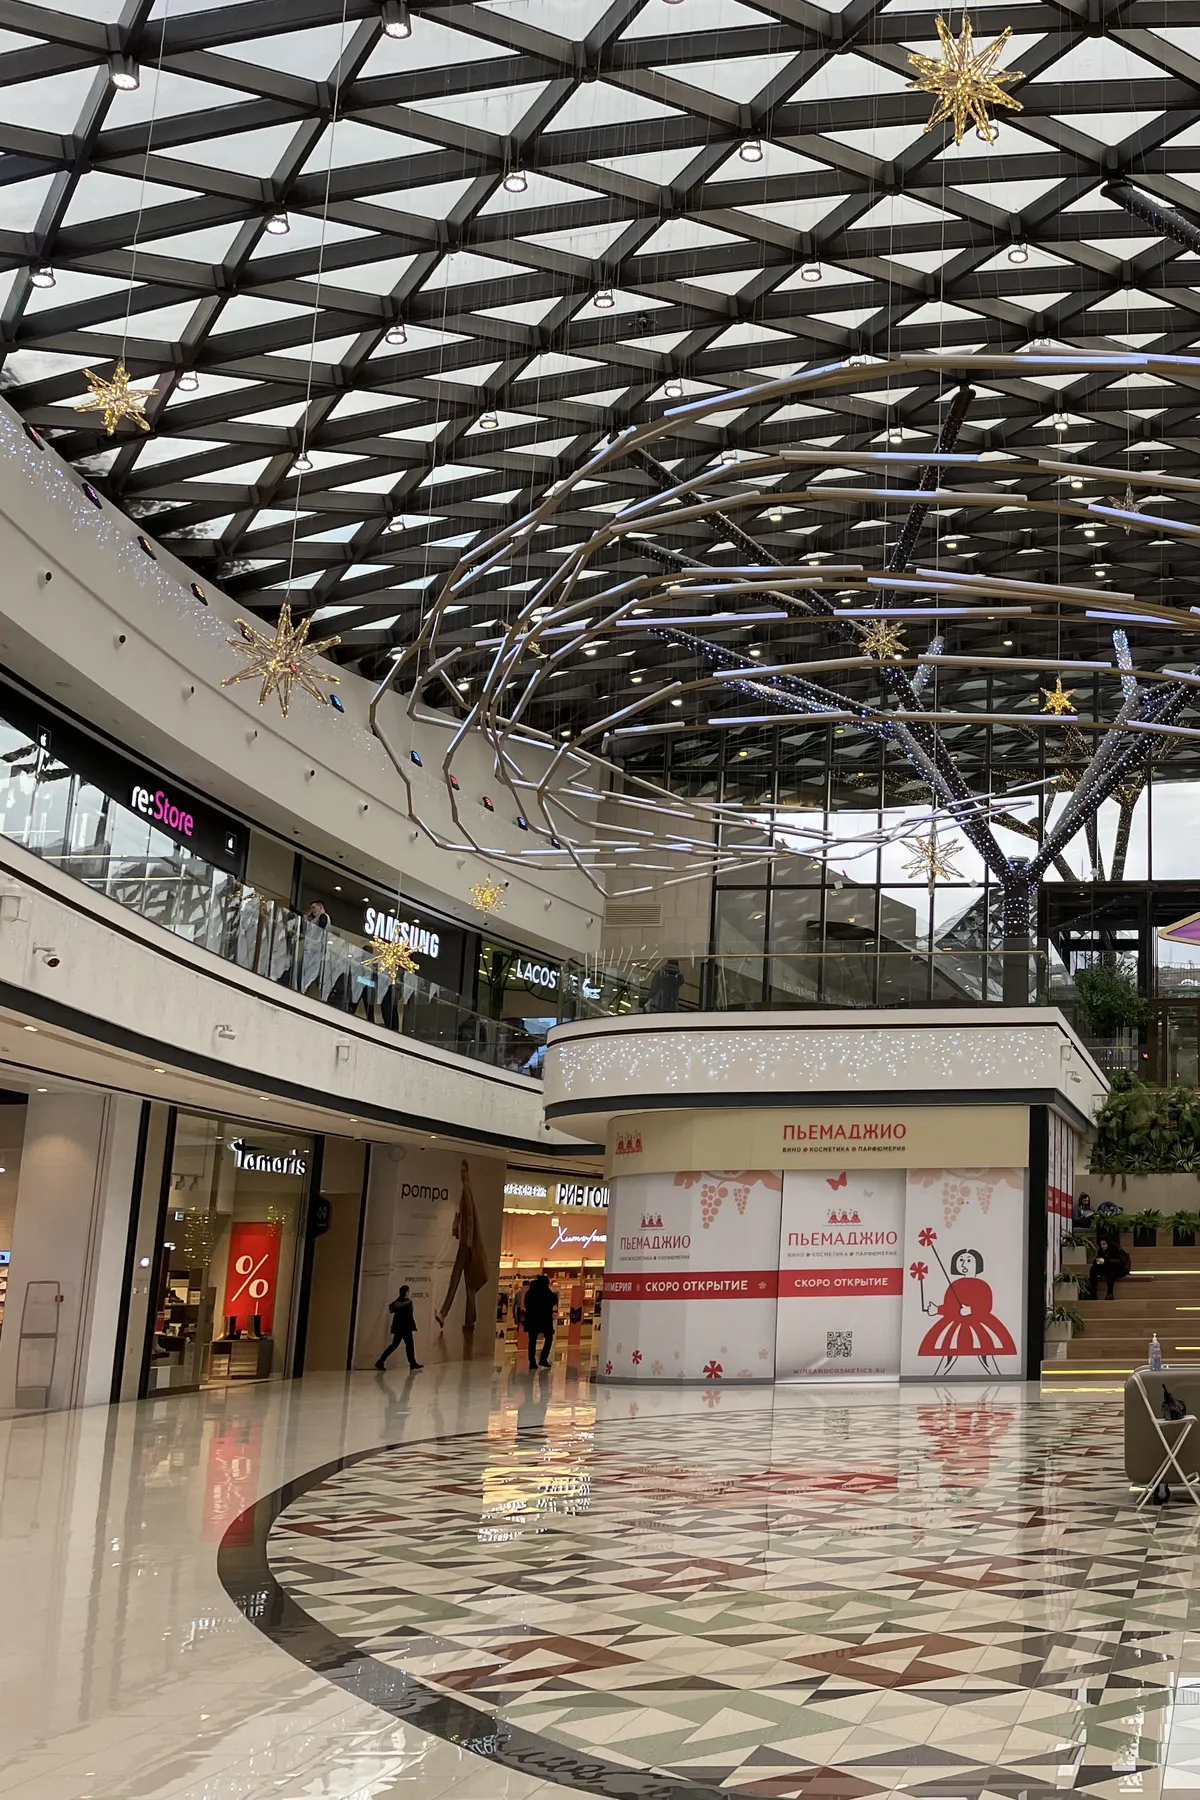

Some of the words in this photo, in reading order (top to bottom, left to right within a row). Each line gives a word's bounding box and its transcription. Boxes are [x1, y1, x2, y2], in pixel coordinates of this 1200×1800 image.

[131, 785, 194, 836] re:Store
[364, 907, 440, 958] SAMSUNG
[516, 959, 579, 995] LACOSE
[783, 1123, 907, 1140] ПЬЕМАДЖИО
[228, 1138, 307, 1176] Tamaris
[401, 1183, 449, 1202] pompa
[620, 1235, 691, 1250] ПЬЕМАДЖИО
[788, 1231, 898, 1246] ПЬЕМАДЖИО
[645, 1281, 680, 1292] СКОРО
[682, 1280, 748, 1292] ОТКРЫТИЕ
[794, 1278, 831, 1287] СКОРО
[833, 1277, 888, 1287] ОТКРЫТИЕ
